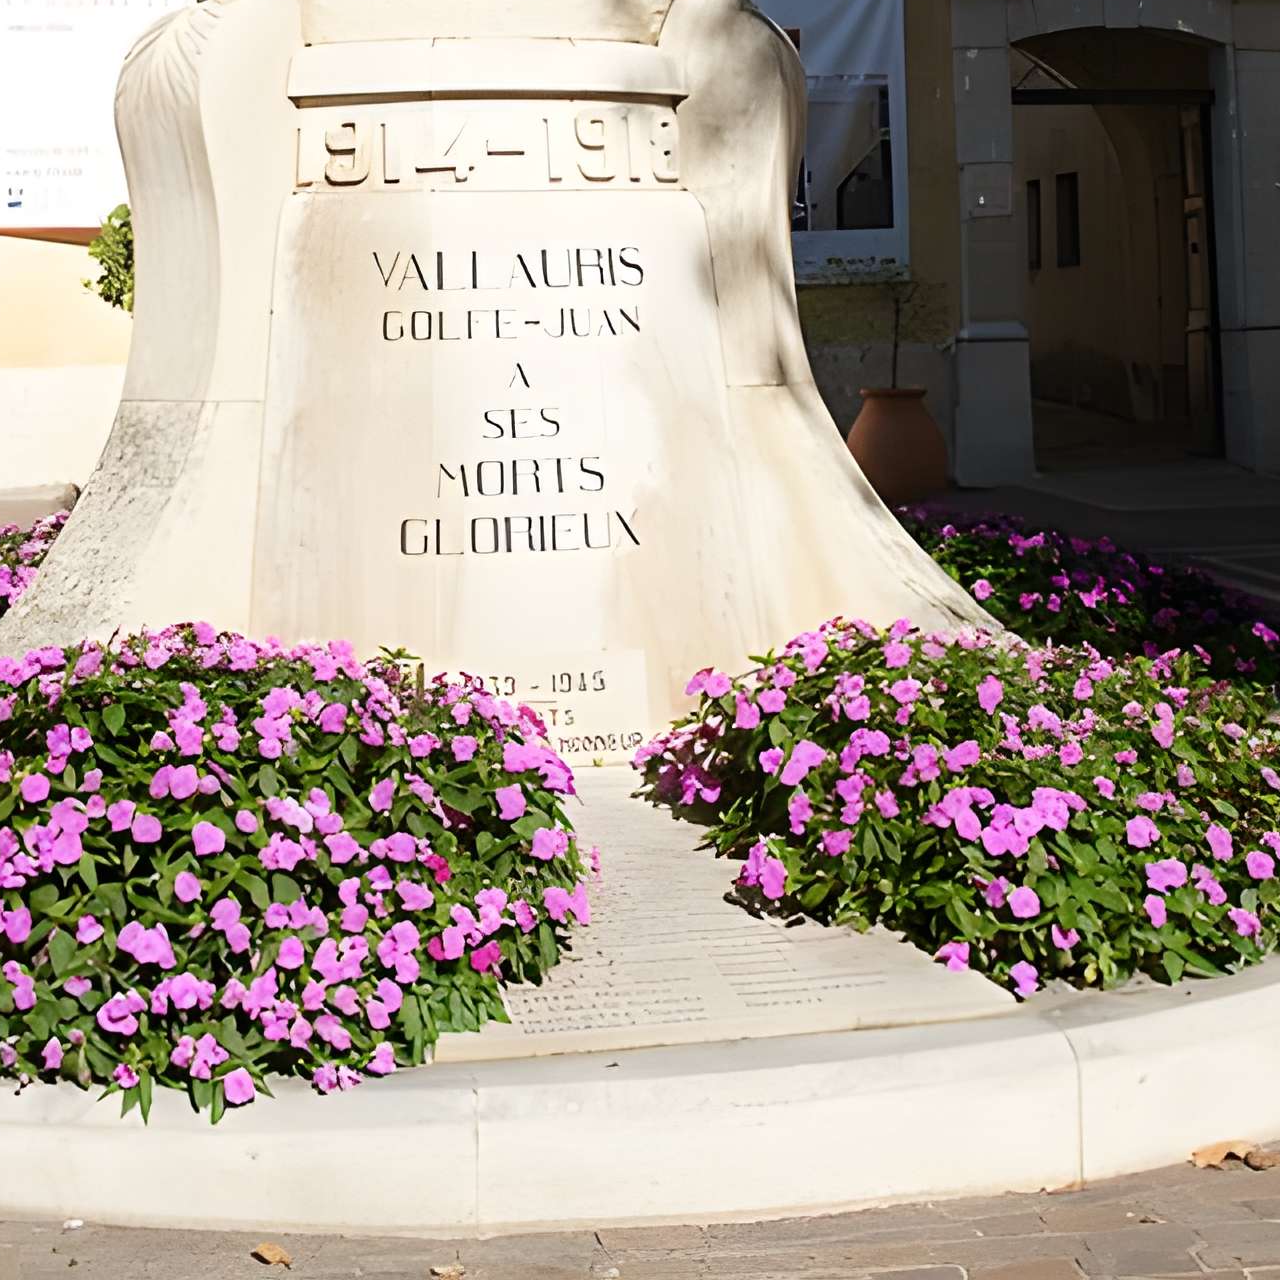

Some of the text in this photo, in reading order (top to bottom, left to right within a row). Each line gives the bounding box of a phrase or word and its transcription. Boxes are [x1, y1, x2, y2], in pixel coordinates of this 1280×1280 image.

[293, 108, 682, 187] 1914-1918
[372, 246, 644, 291] VALLAURIS
[382, 305, 641, 341] GOLFE-JUAN
[509, 361, 530, 389] A
[482, 407, 560, 439] SES
[437, 456, 605, 499] MORTS
[400, 508, 641, 556] GLORIEUX
